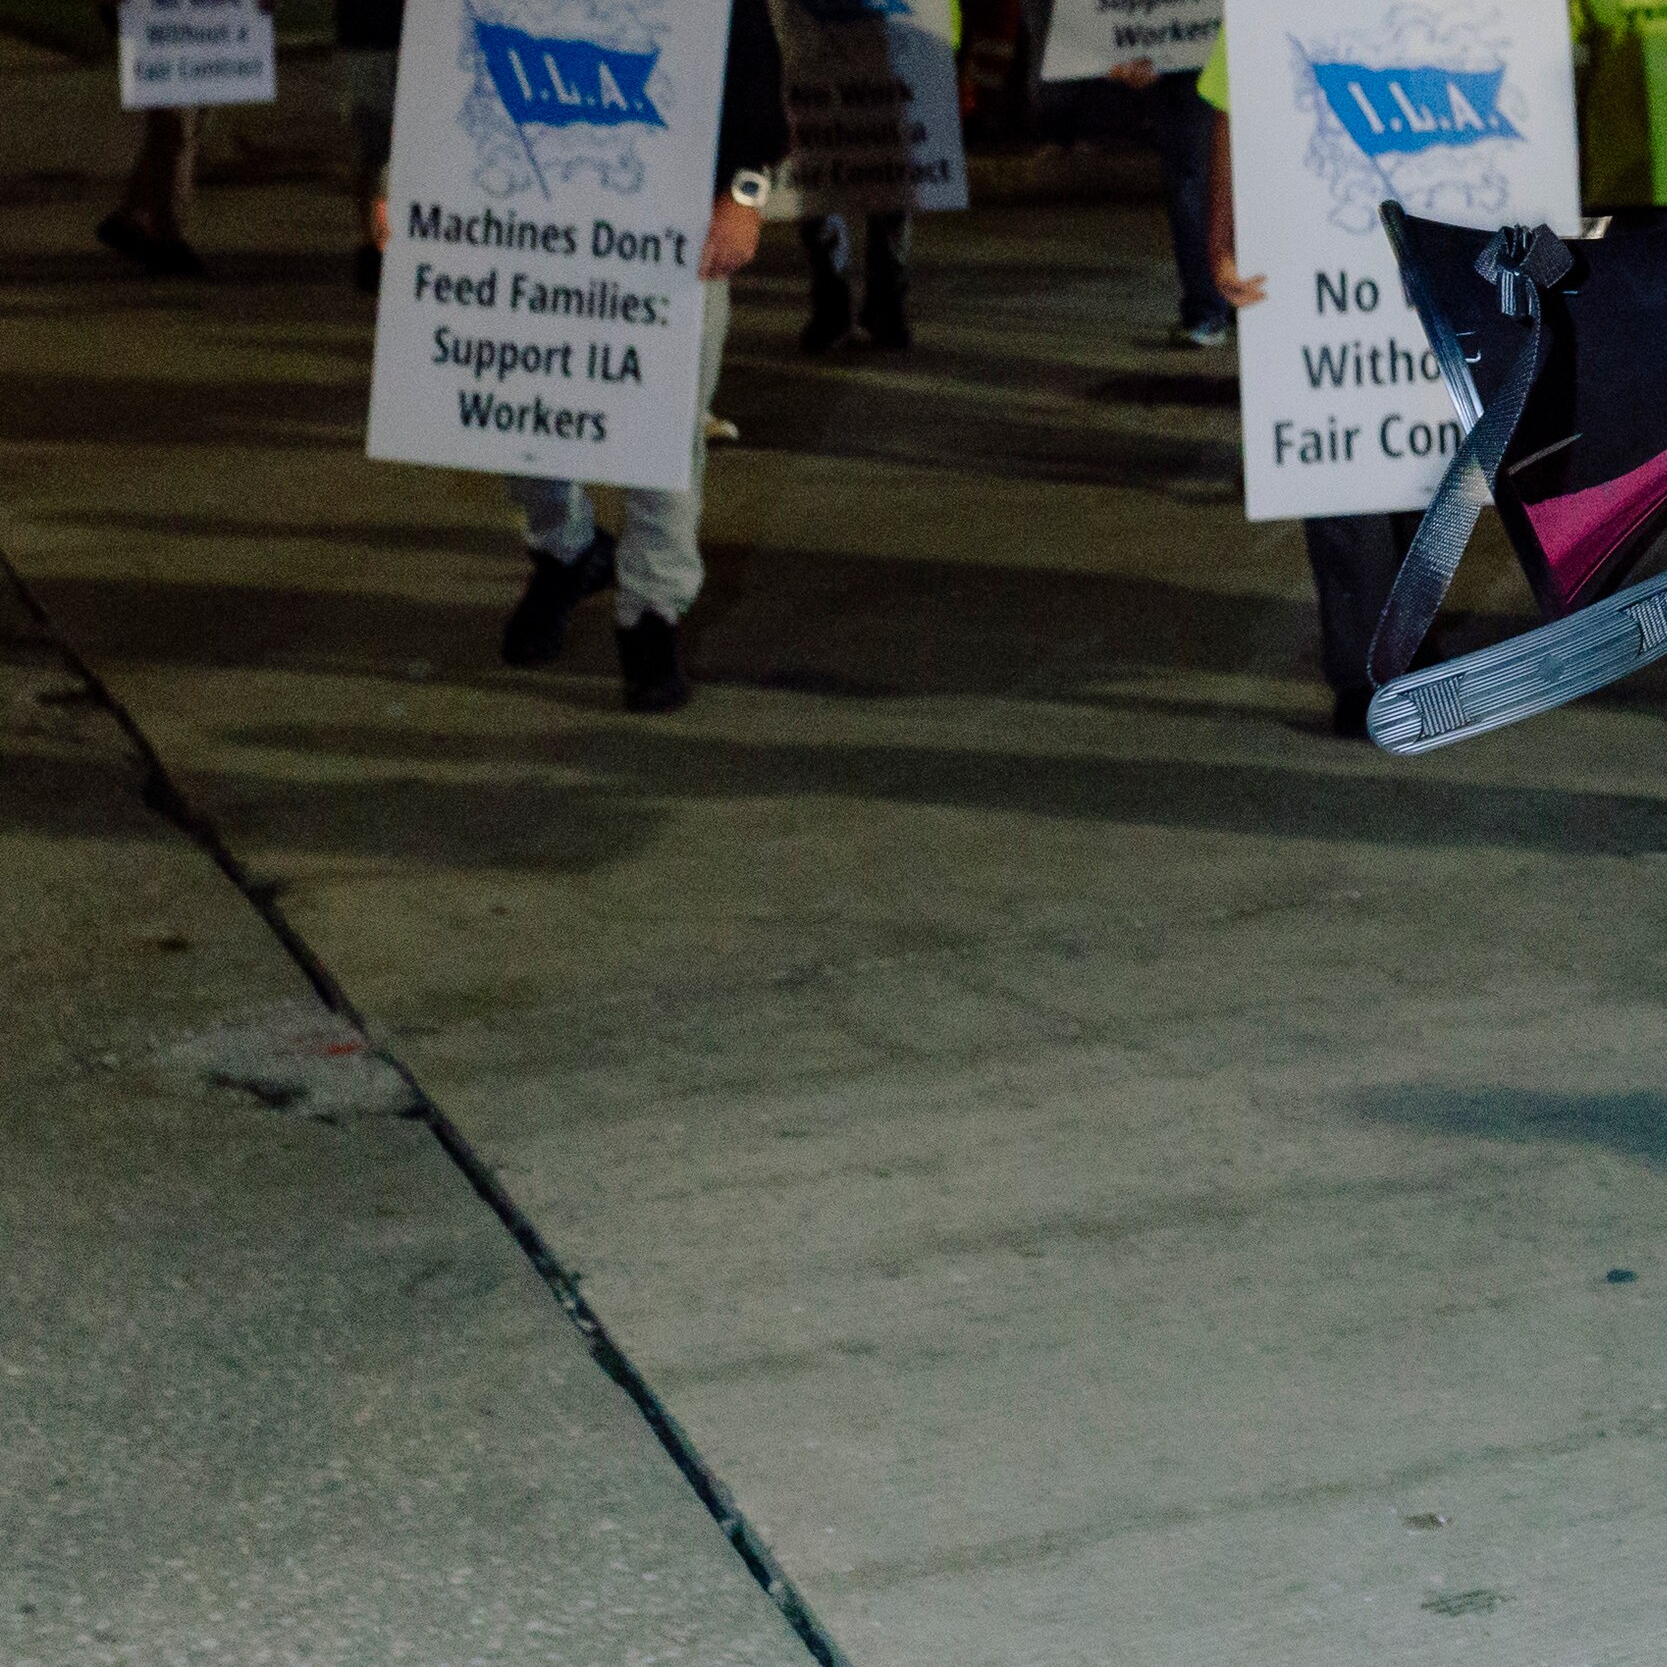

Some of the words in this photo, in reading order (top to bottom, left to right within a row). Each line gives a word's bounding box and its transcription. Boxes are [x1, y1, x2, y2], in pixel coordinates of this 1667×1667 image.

[507, 48, 644, 114] I.L.A.
[1349, 82, 1498, 134] I.L.A.
[408, 200, 577, 257] Machines
[591, 216, 688, 268] Don't
[413, 262, 498, 310] Feed
[509, 272, 670, 328] Families:
[1314, 270, 1379, 315] No
[433, 324, 573, 383] Support
[586, 342, 642, 384] ILA
[1302, 340, 1441, 389] Witho
[457, 386, 609, 443] Workers
[1272, 419, 1362, 467] Fair
